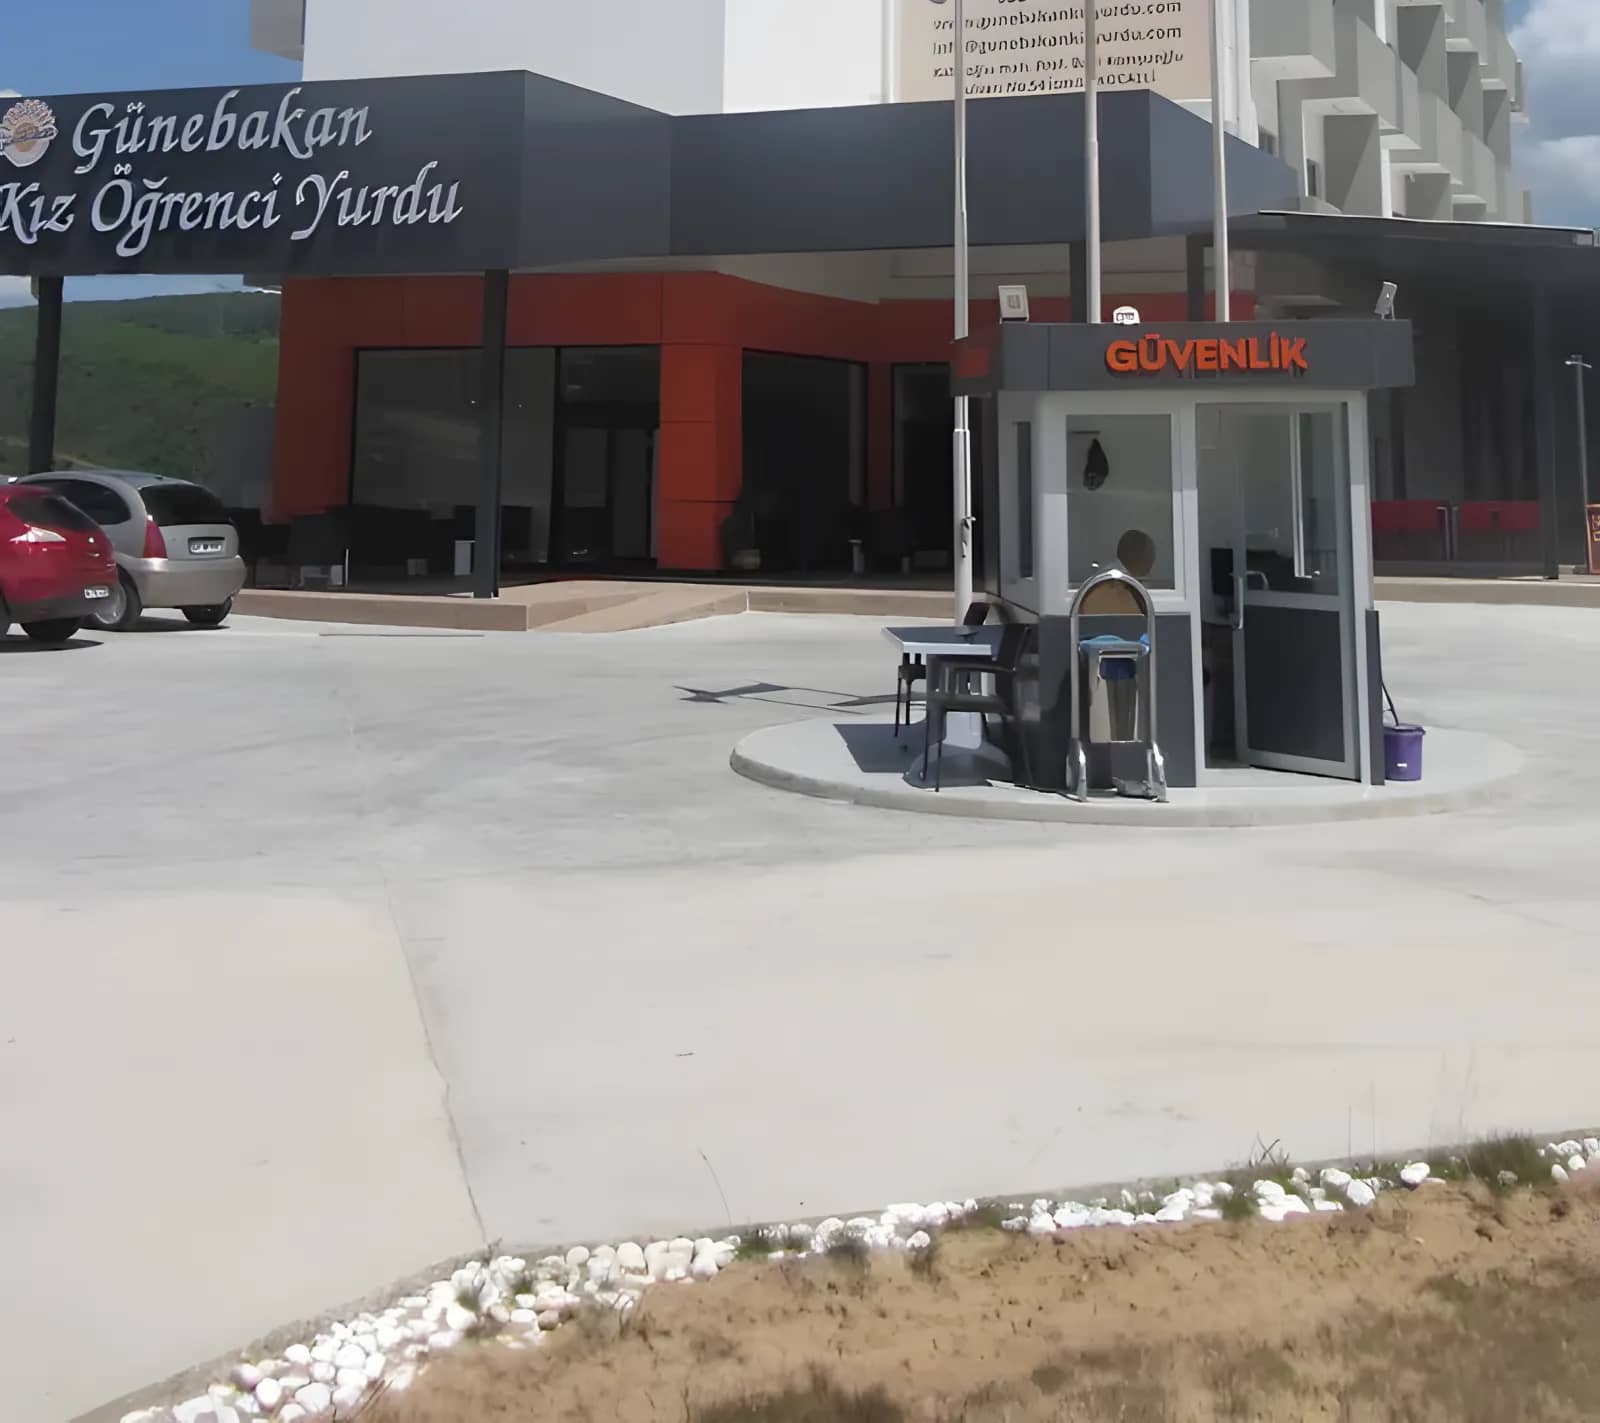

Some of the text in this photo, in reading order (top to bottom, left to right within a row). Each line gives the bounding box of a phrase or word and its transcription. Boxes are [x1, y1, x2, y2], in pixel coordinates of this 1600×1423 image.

[73, 87, 373, 174] Günebakan
[0, 160, 464, 257] Kız Öğrenci Yurdu
[1106, 330, 1308, 372] GÜVENLİK
